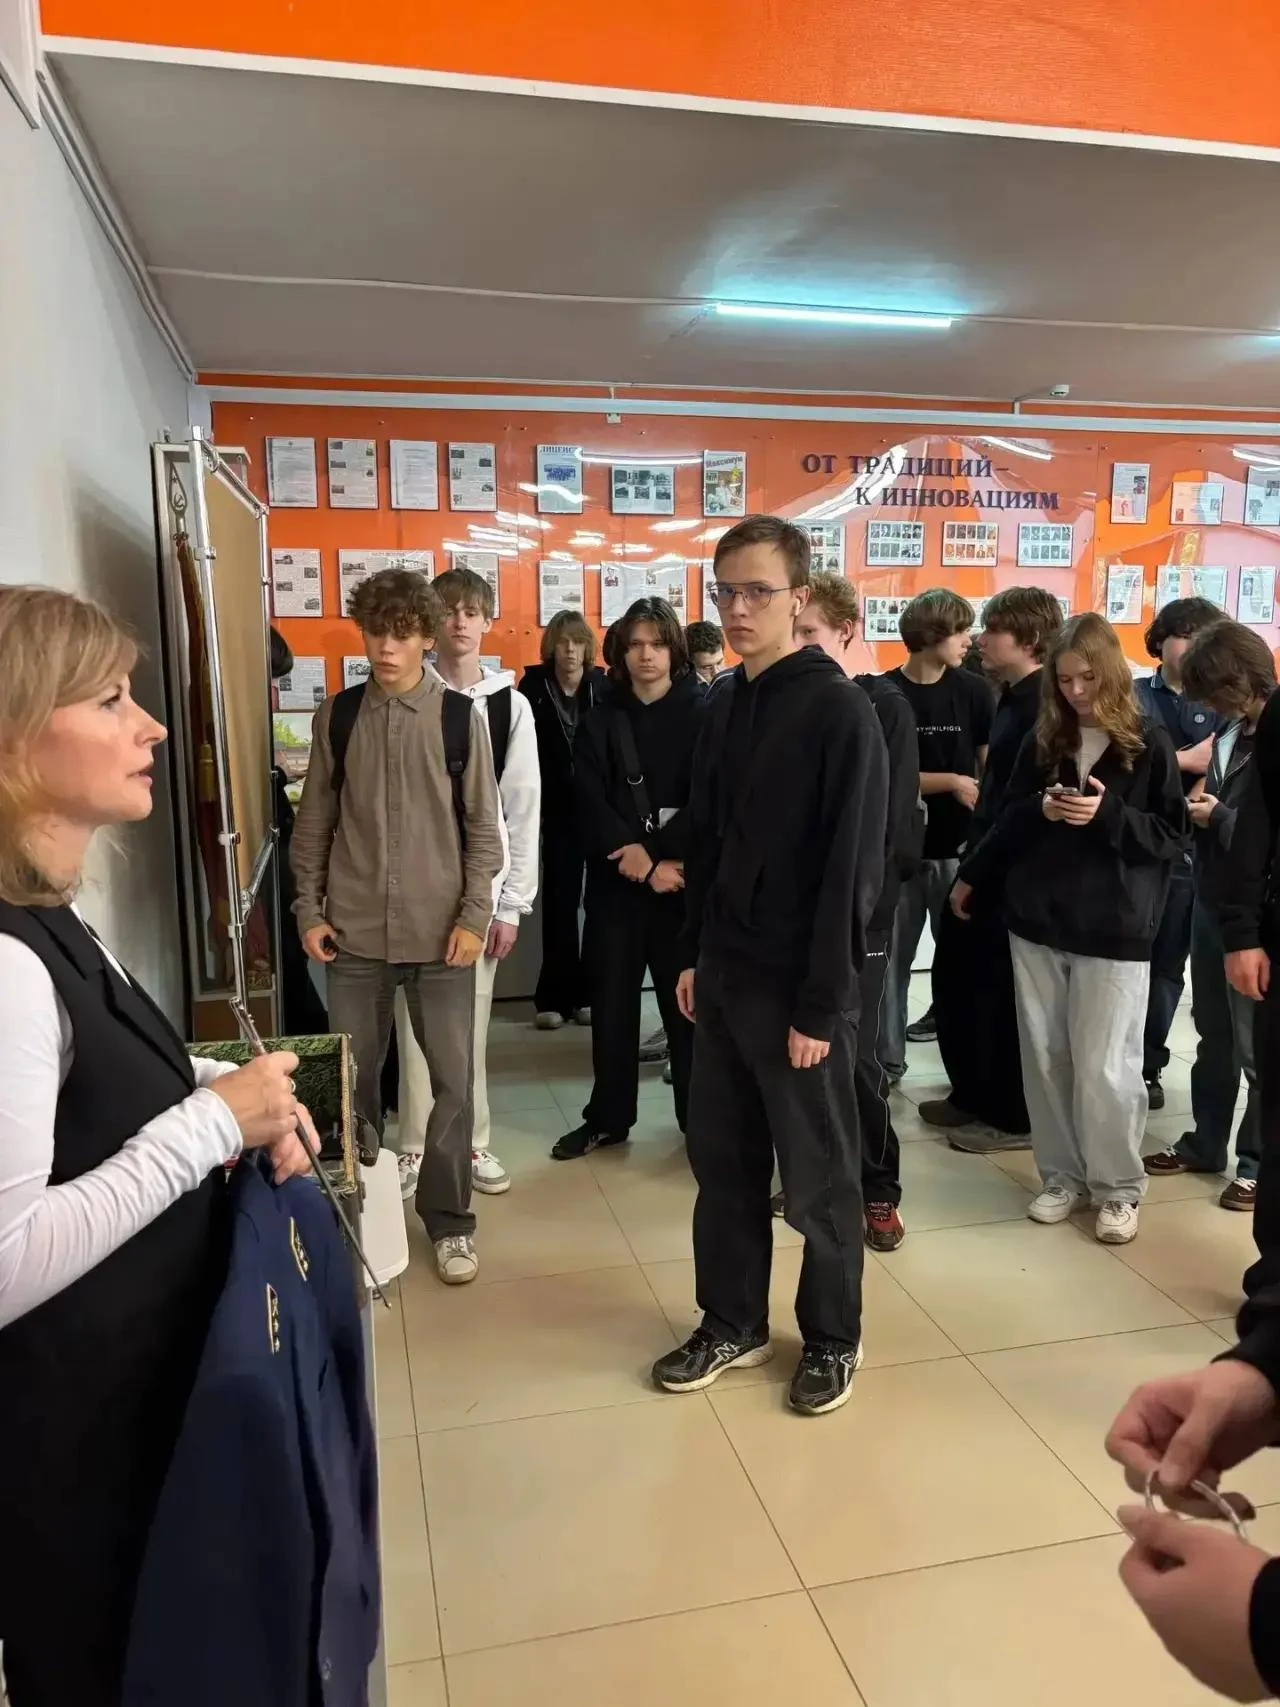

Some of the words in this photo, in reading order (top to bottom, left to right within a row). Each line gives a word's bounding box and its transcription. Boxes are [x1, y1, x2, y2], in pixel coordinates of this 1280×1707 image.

[802, 454, 838, 474] ОТ
[856, 487, 872, 506] К
[881, 487, 1060, 512] ИННОВАЦИЯМ
